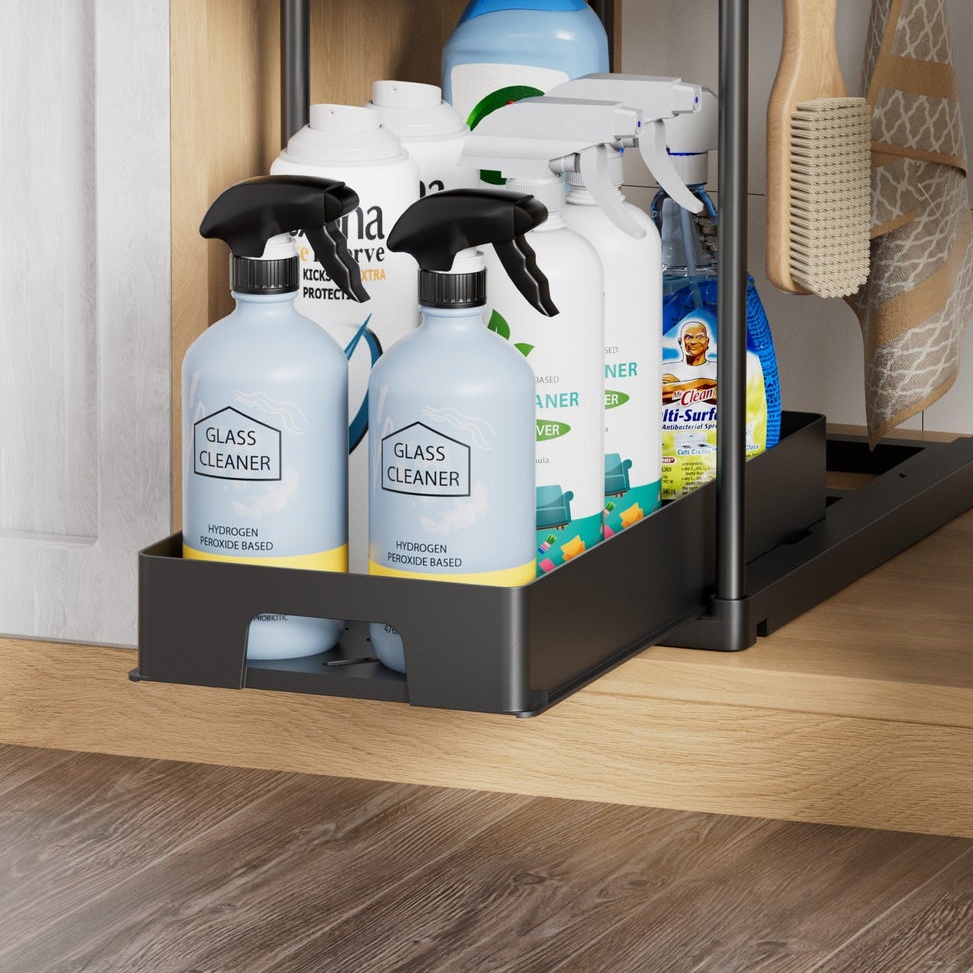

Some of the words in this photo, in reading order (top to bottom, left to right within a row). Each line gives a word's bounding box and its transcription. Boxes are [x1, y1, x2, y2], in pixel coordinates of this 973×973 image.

[680, 389, 713, 406] Clean
[662, 407, 717, 423] lti-Surf
[205, 426, 257, 446] GLASS
[393, 442, 446, 462] GLASS
[199, 450, 271, 471] CLEANER
[387, 465, 460, 487] CLEANER
[207, 524, 259, 538] HYDROGEN
[200, 535, 240, 551] PEROXIDE
[241, 541, 274, 551] BASED
[395, 540, 448, 554] HYDROGEN
[387, 552, 428, 567] PEROXIDE
[429, 557, 463, 568] BASED
